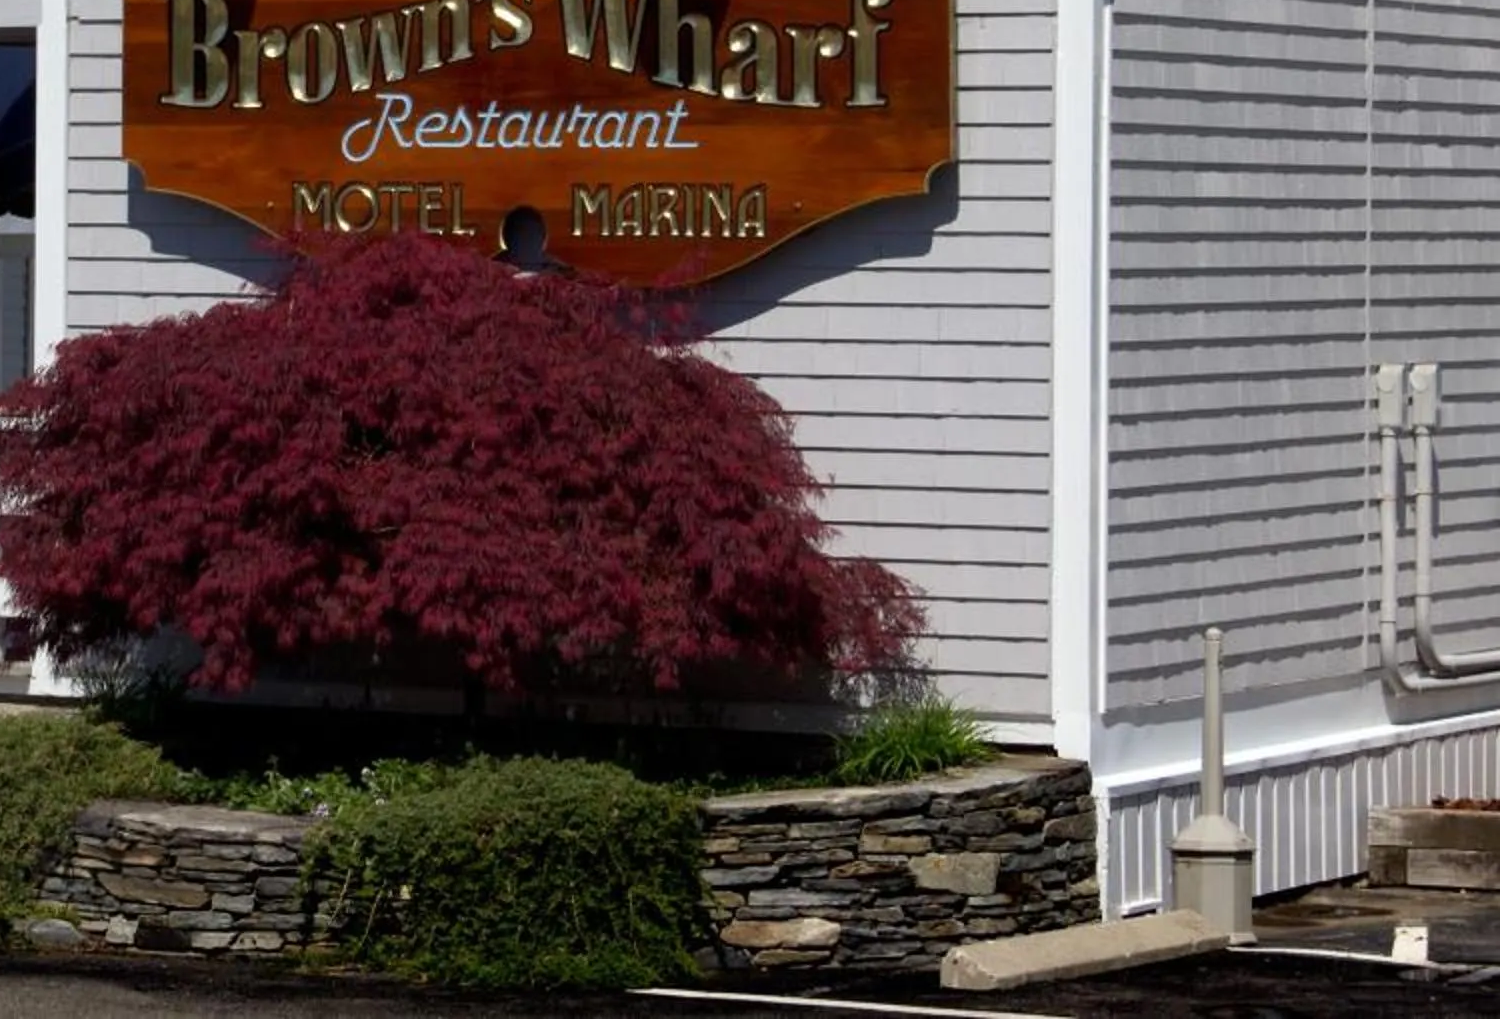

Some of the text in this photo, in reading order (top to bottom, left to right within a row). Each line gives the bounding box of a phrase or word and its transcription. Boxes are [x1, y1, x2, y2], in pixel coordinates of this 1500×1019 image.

[341, 92, 700, 163] Restaurant
[293, 182, 767, 238] MOTEL MARINA
